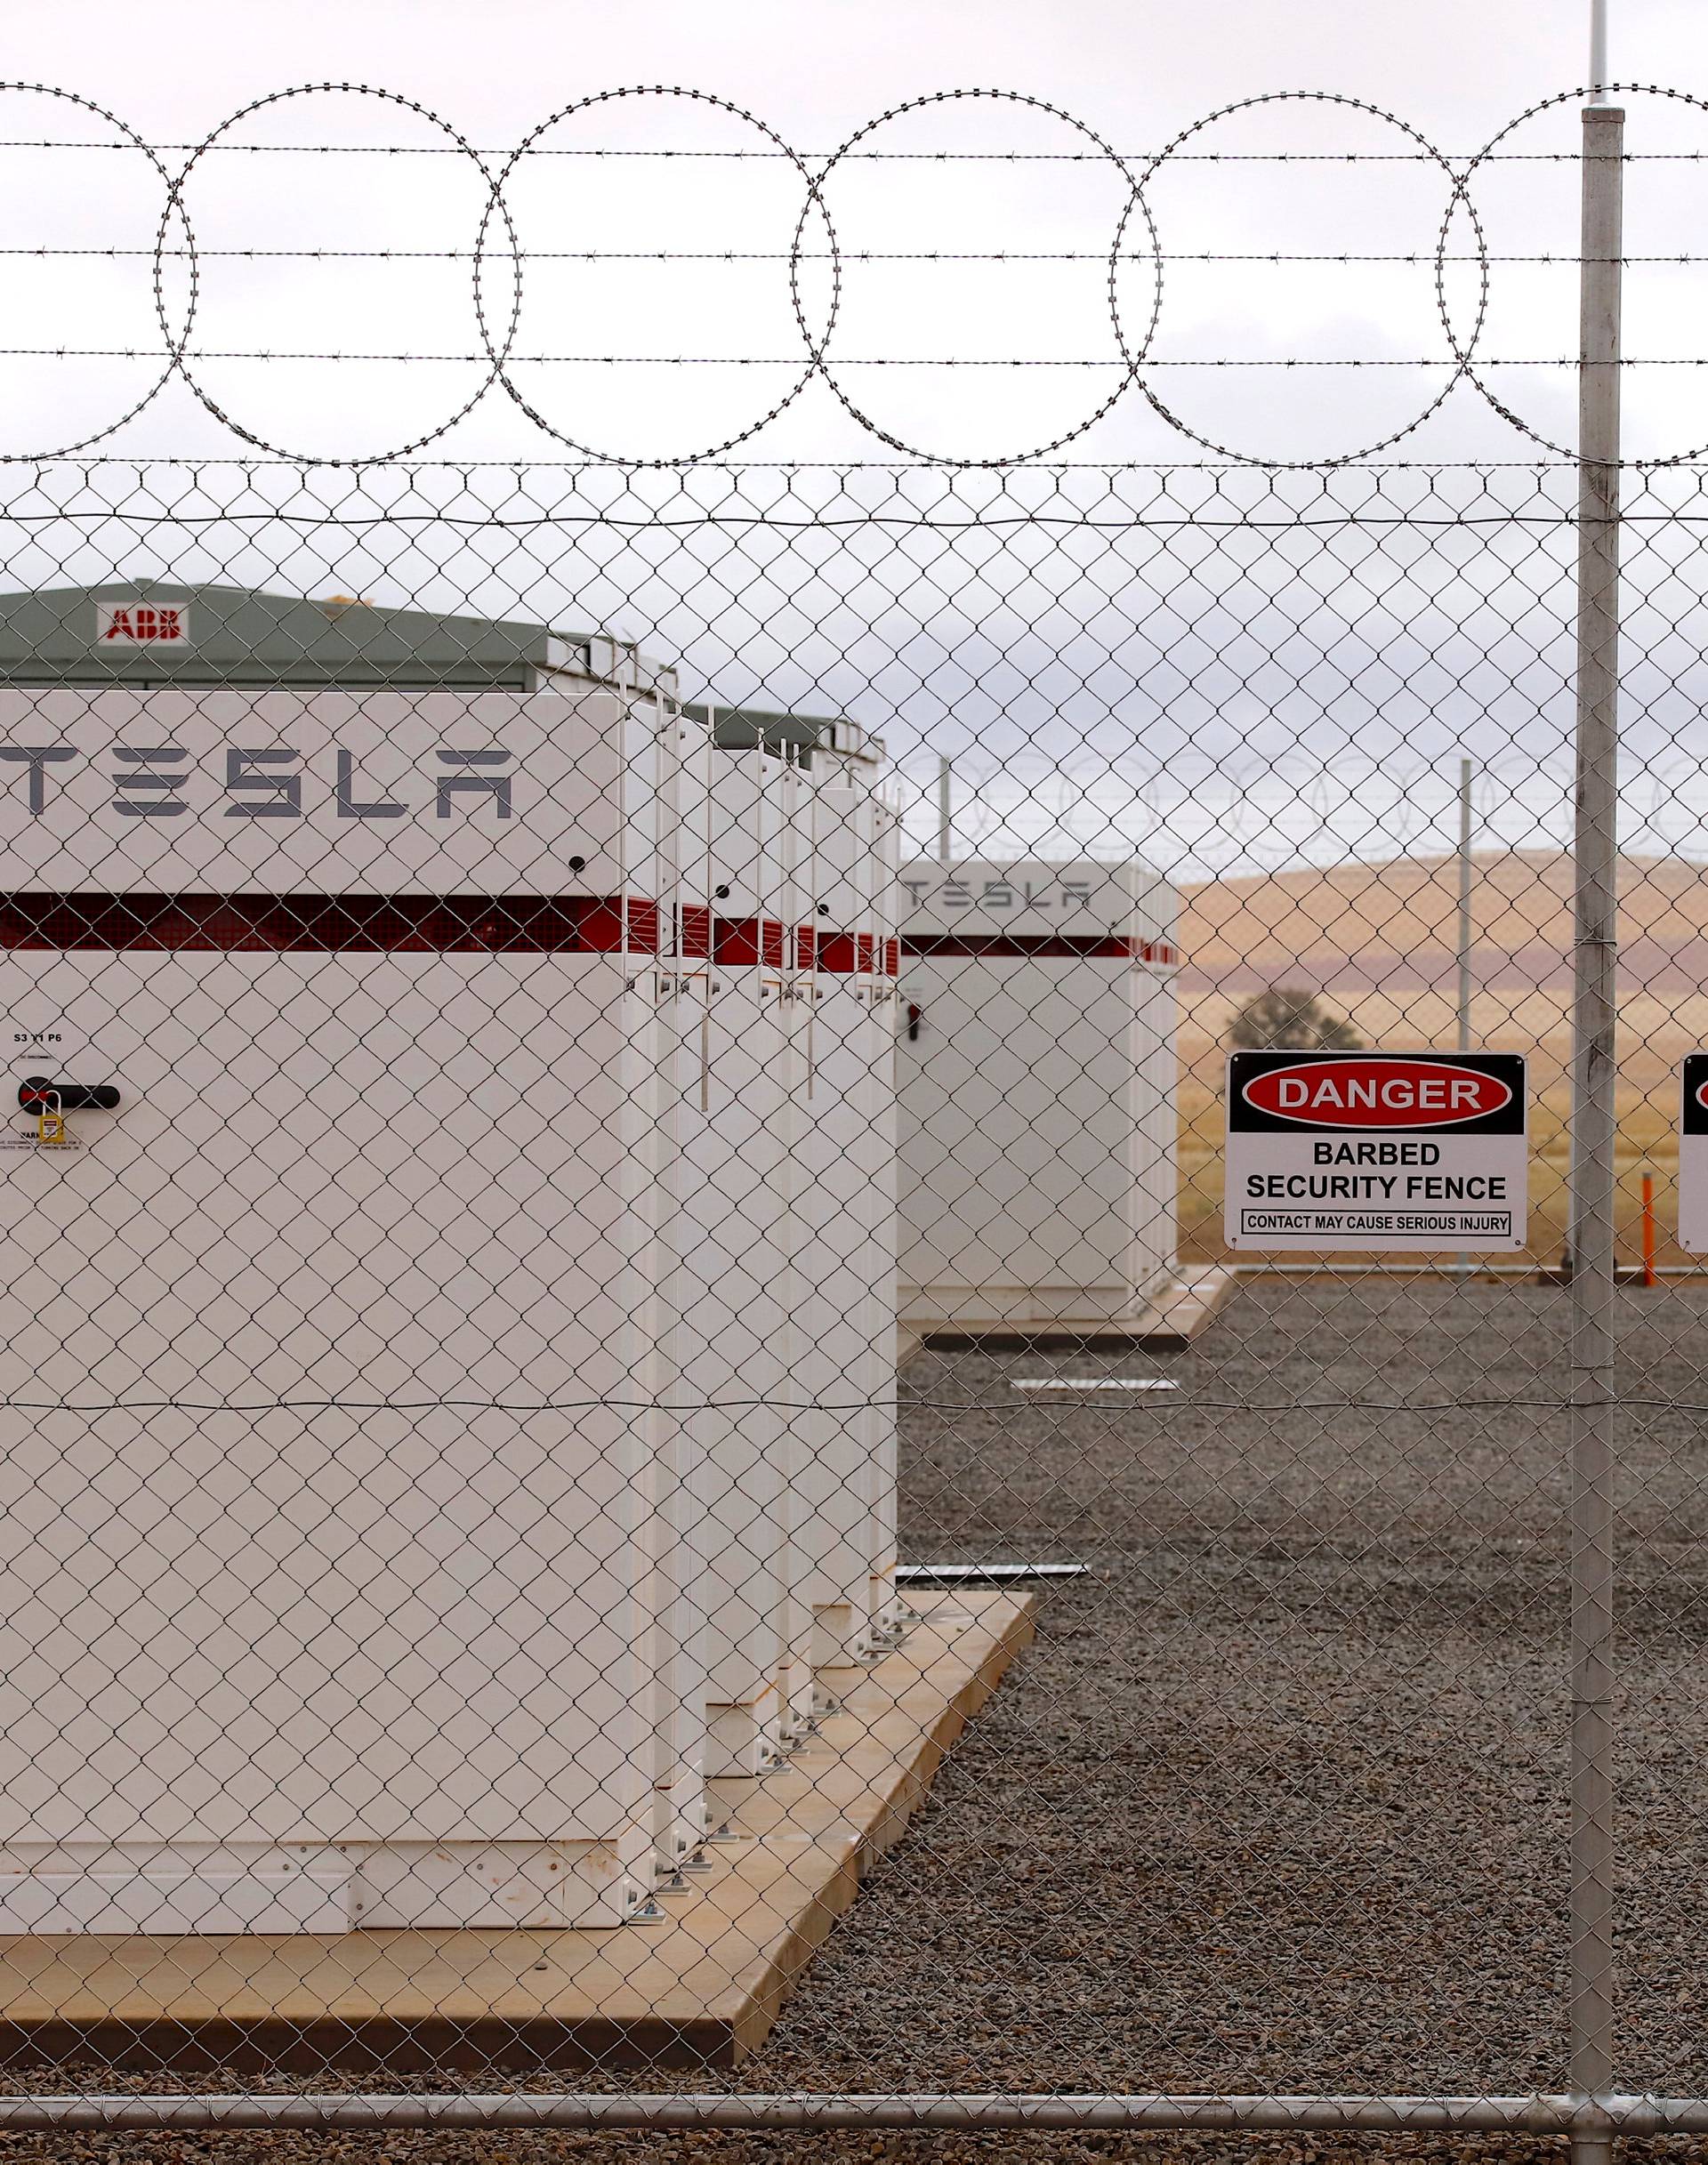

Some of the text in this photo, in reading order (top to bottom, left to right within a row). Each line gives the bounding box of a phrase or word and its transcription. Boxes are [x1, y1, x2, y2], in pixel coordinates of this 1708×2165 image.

[107, 610, 181, 640] ABB
[0, 746, 512, 818] TESLA
[904, 881, 1090, 907] TESLA
[13, 1034, 28, 1042] S3
[48, 1034, 62, 1042] P6
[1278, 1078, 1483, 1109] DANGER
[1313, 1142, 1440, 1166] BARBED
[1246, 1174, 1507, 1200] SECURITY FENCE
[1247, 1214, 1509, 1230] CONTACT MAY CAUSE SERIOUS INJURY
